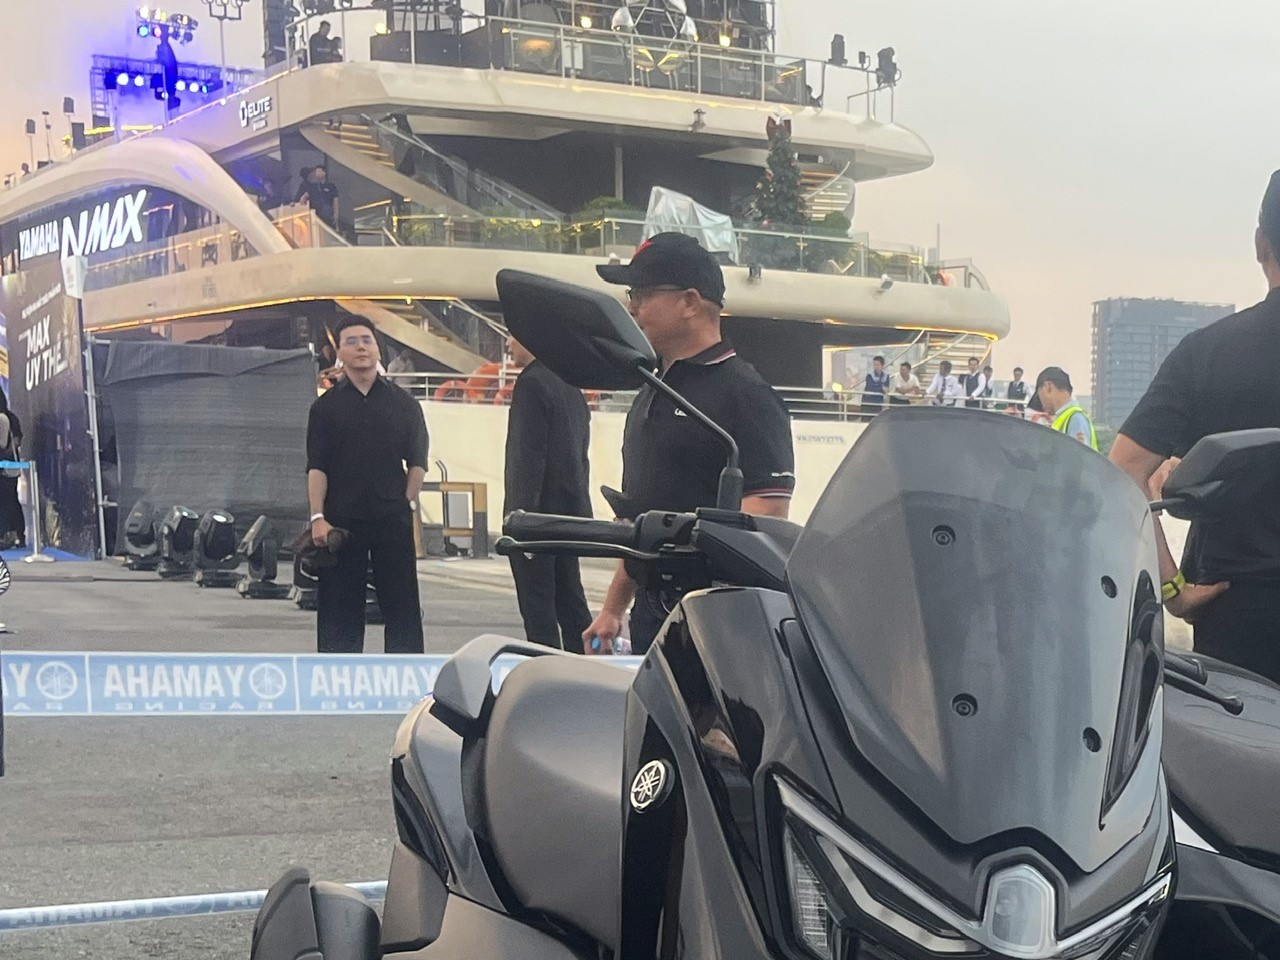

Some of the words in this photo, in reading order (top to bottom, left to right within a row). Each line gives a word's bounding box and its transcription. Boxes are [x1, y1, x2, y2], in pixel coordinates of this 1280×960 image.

[248, 96, 271, 118] ELITE
[19, 220, 60, 261] YAMAHA
[61, 189, 147, 261] NMAX
